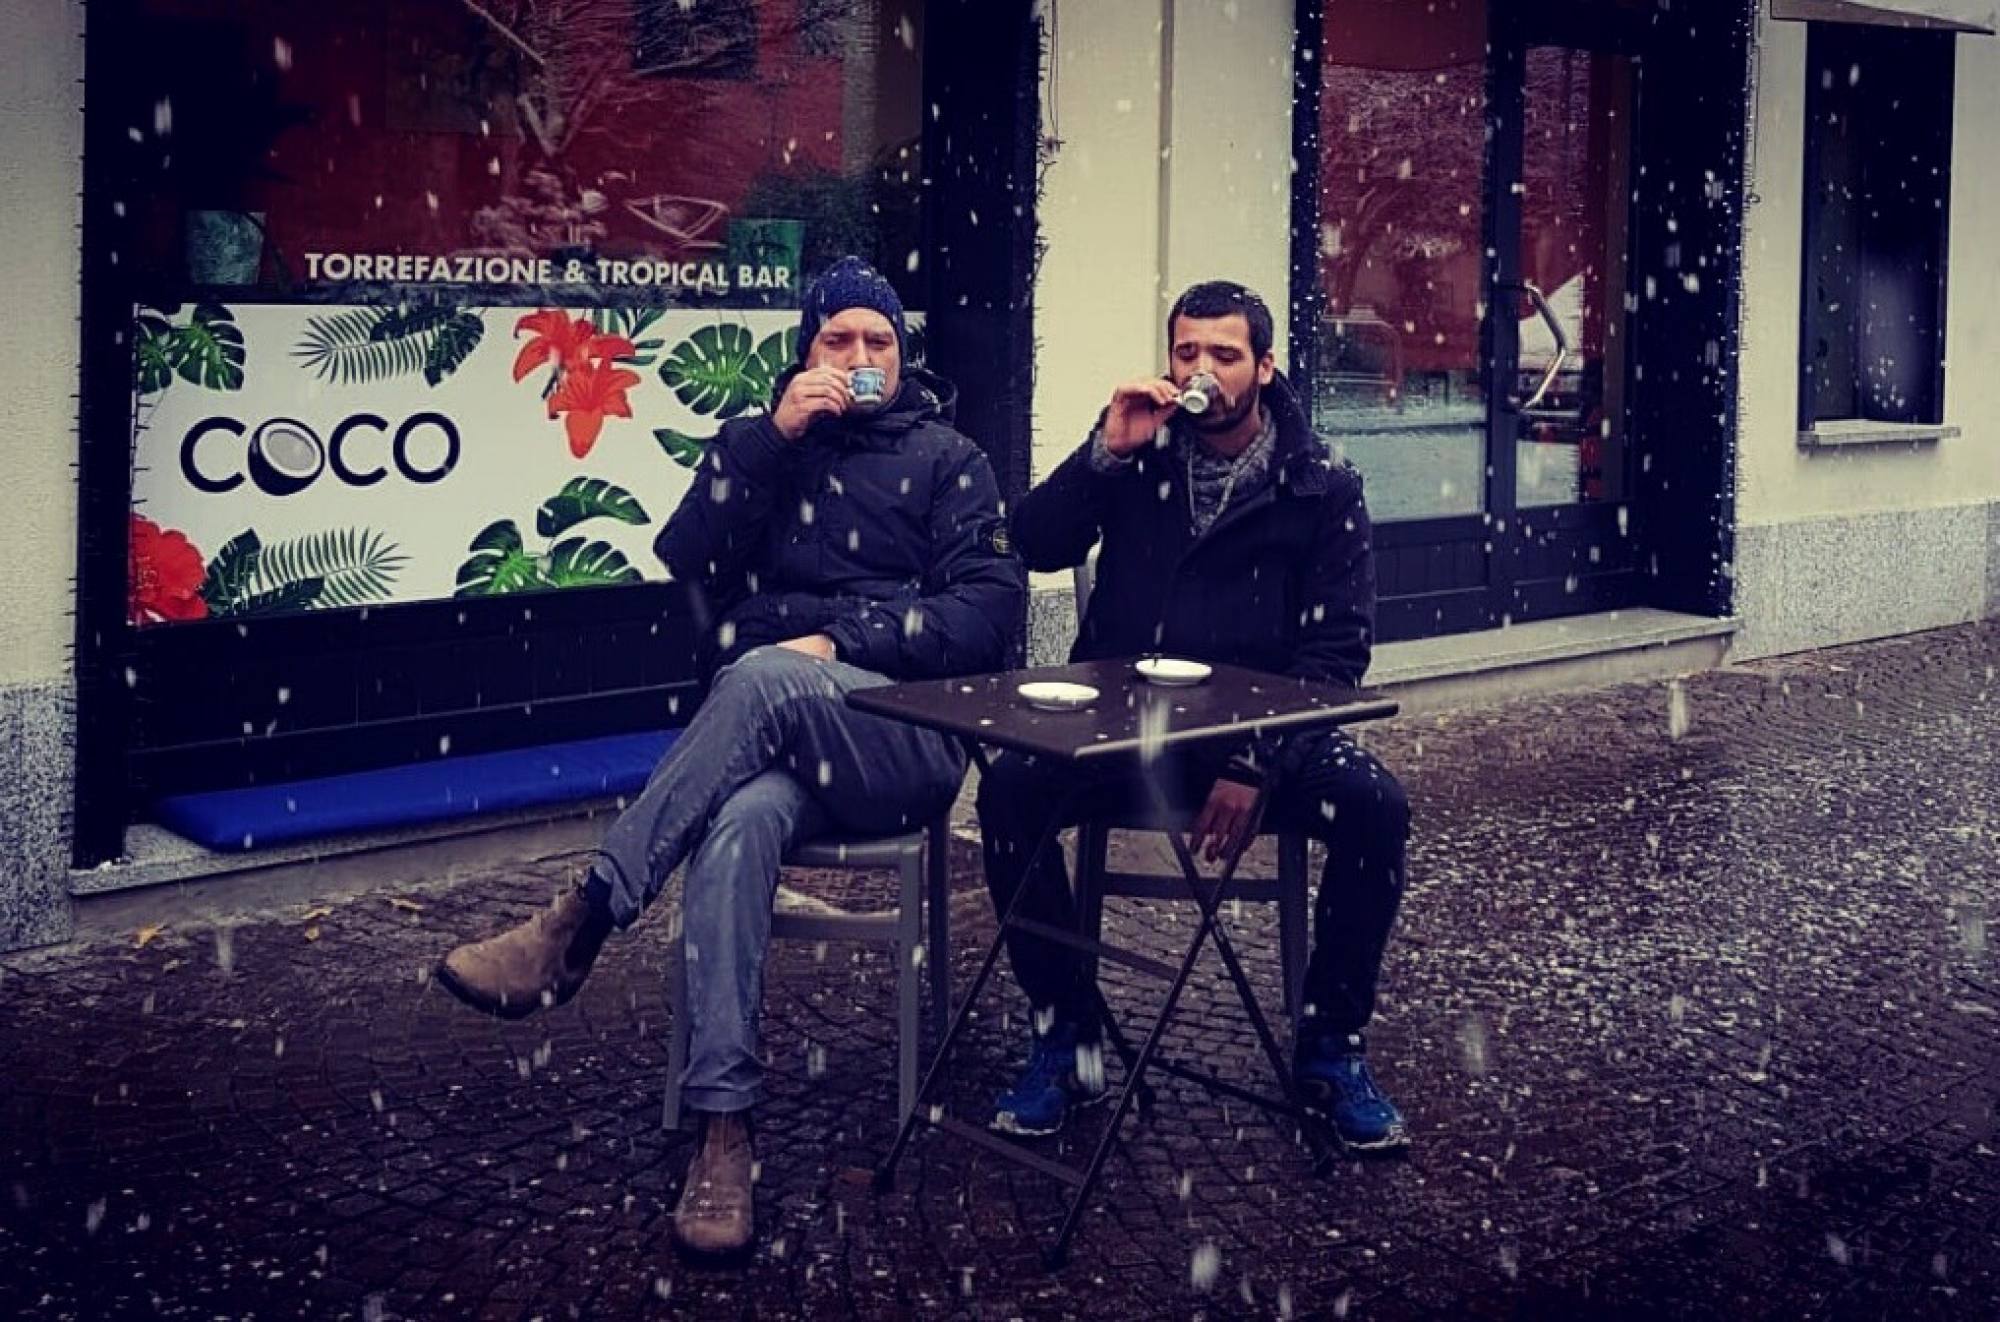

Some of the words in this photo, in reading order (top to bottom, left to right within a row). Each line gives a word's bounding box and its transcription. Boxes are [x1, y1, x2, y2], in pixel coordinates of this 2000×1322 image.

[304, 252, 552, 284] TORREFAZIONE
[563, 260, 587, 284] &
[598, 259, 729, 288] TROPICAL
[738, 265, 791, 289] BAR
[179, 412, 461, 496] COCO
